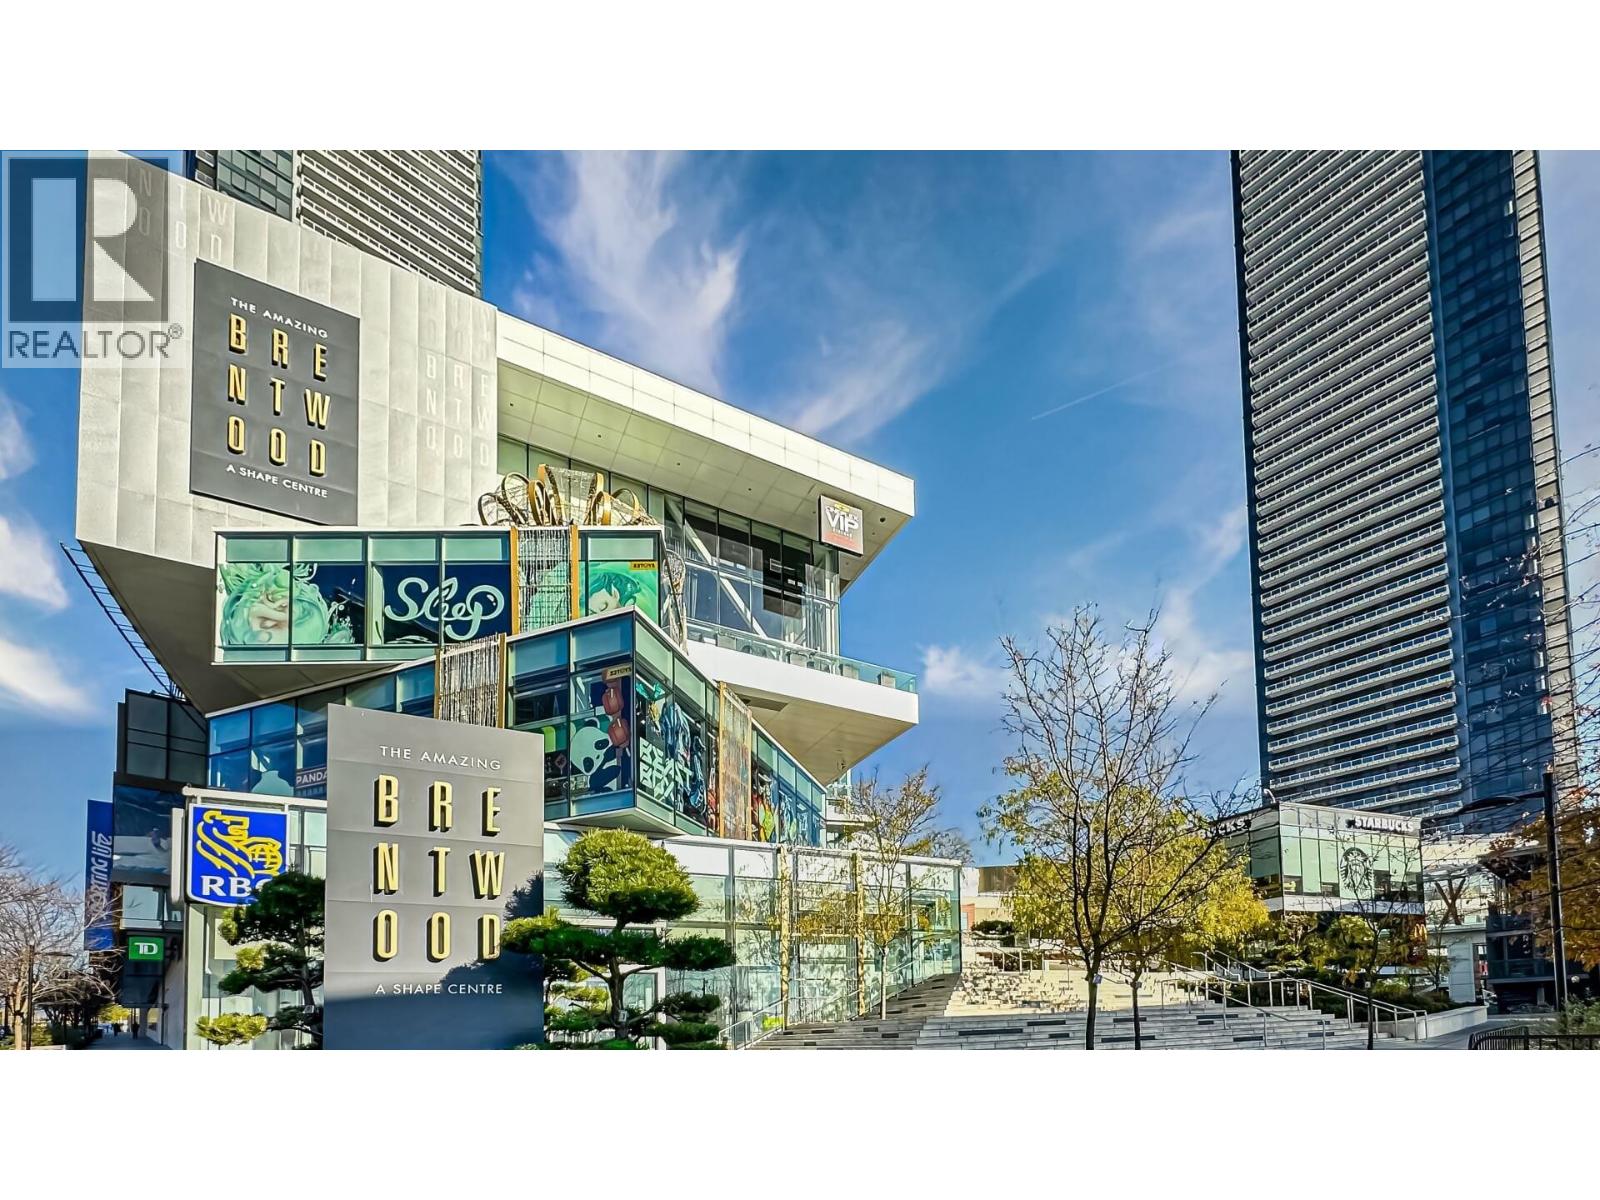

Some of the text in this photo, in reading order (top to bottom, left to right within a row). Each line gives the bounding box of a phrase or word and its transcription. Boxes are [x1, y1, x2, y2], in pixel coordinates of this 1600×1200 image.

[230, 296, 329, 339] THE AMAZING
[226, 464, 329, 499] A SHAPE CENTRE
[825, 506, 860, 533] VIP
[384, 576, 505, 641] Sleep
[379, 745, 502, 770] THE AMAZING
[1354, 815, 1415, 833] STARBUCKS
[134, 942, 160, 955] TD
[375, 983, 503, 995] A SHAPE CENTRE
